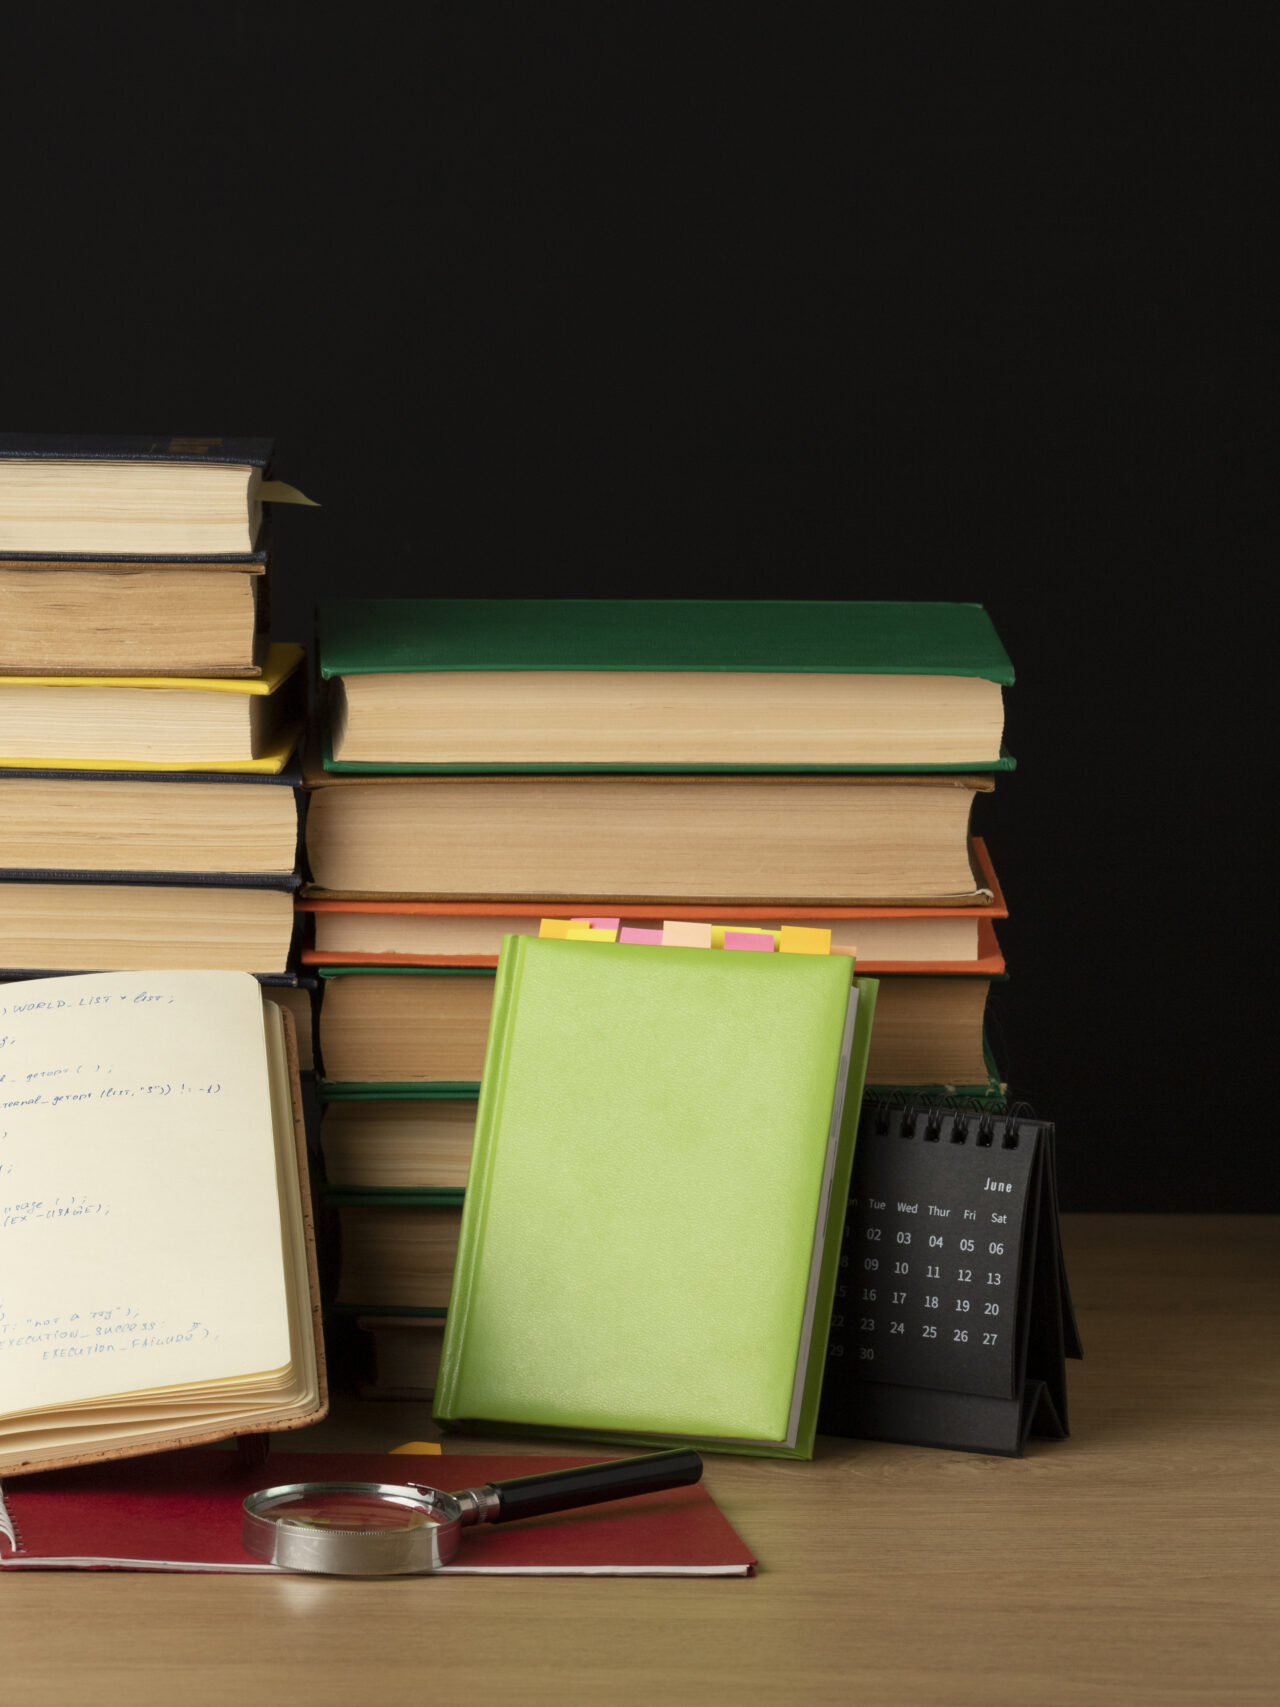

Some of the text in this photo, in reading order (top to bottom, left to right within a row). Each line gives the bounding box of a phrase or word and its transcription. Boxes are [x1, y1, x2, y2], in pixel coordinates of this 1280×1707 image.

[983, 1176, 1014, 1194] June
[868, 1198, 887, 1211] Tue
[896, 1201, 919, 1214] Wed
[927, 1205, 951, 1218] Thur
[963, 1209, 977, 1221] Fri
[990, 1212, 1008, 1225] Sat
[866, 1228, 882, 1242] 02
[896, 1231, 912, 1245] 03
[928, 1235, 944, 1249] 04
[959, 1238, 975, 1252] 05
[988, 1242, 1005, 1256] 06
[863, 1257, 880, 1271] 09
[893, 1261, 910, 1275] 10
[926, 1265, 941, 1279] 11
[956, 1269, 973, 1283] 12
[986, 1272, 1002, 1286] 13
[861, 1288, 877, 1302] 16
[891, 1291, 908, 1305] 17
[924, 1295, 939, 1309] 18
[955, 1299, 971, 1313] 19
[983, 1302, 1000, 1316] 20
[859, 1318, 876, 1332] 23
[889, 1321, 905, 1335] 24
[921, 1325, 938, 1339] 25
[952, 1329, 969, 1343] 26
[982, 1332, 998, 1347] 27
[858, 1347, 875, 1360] 30
